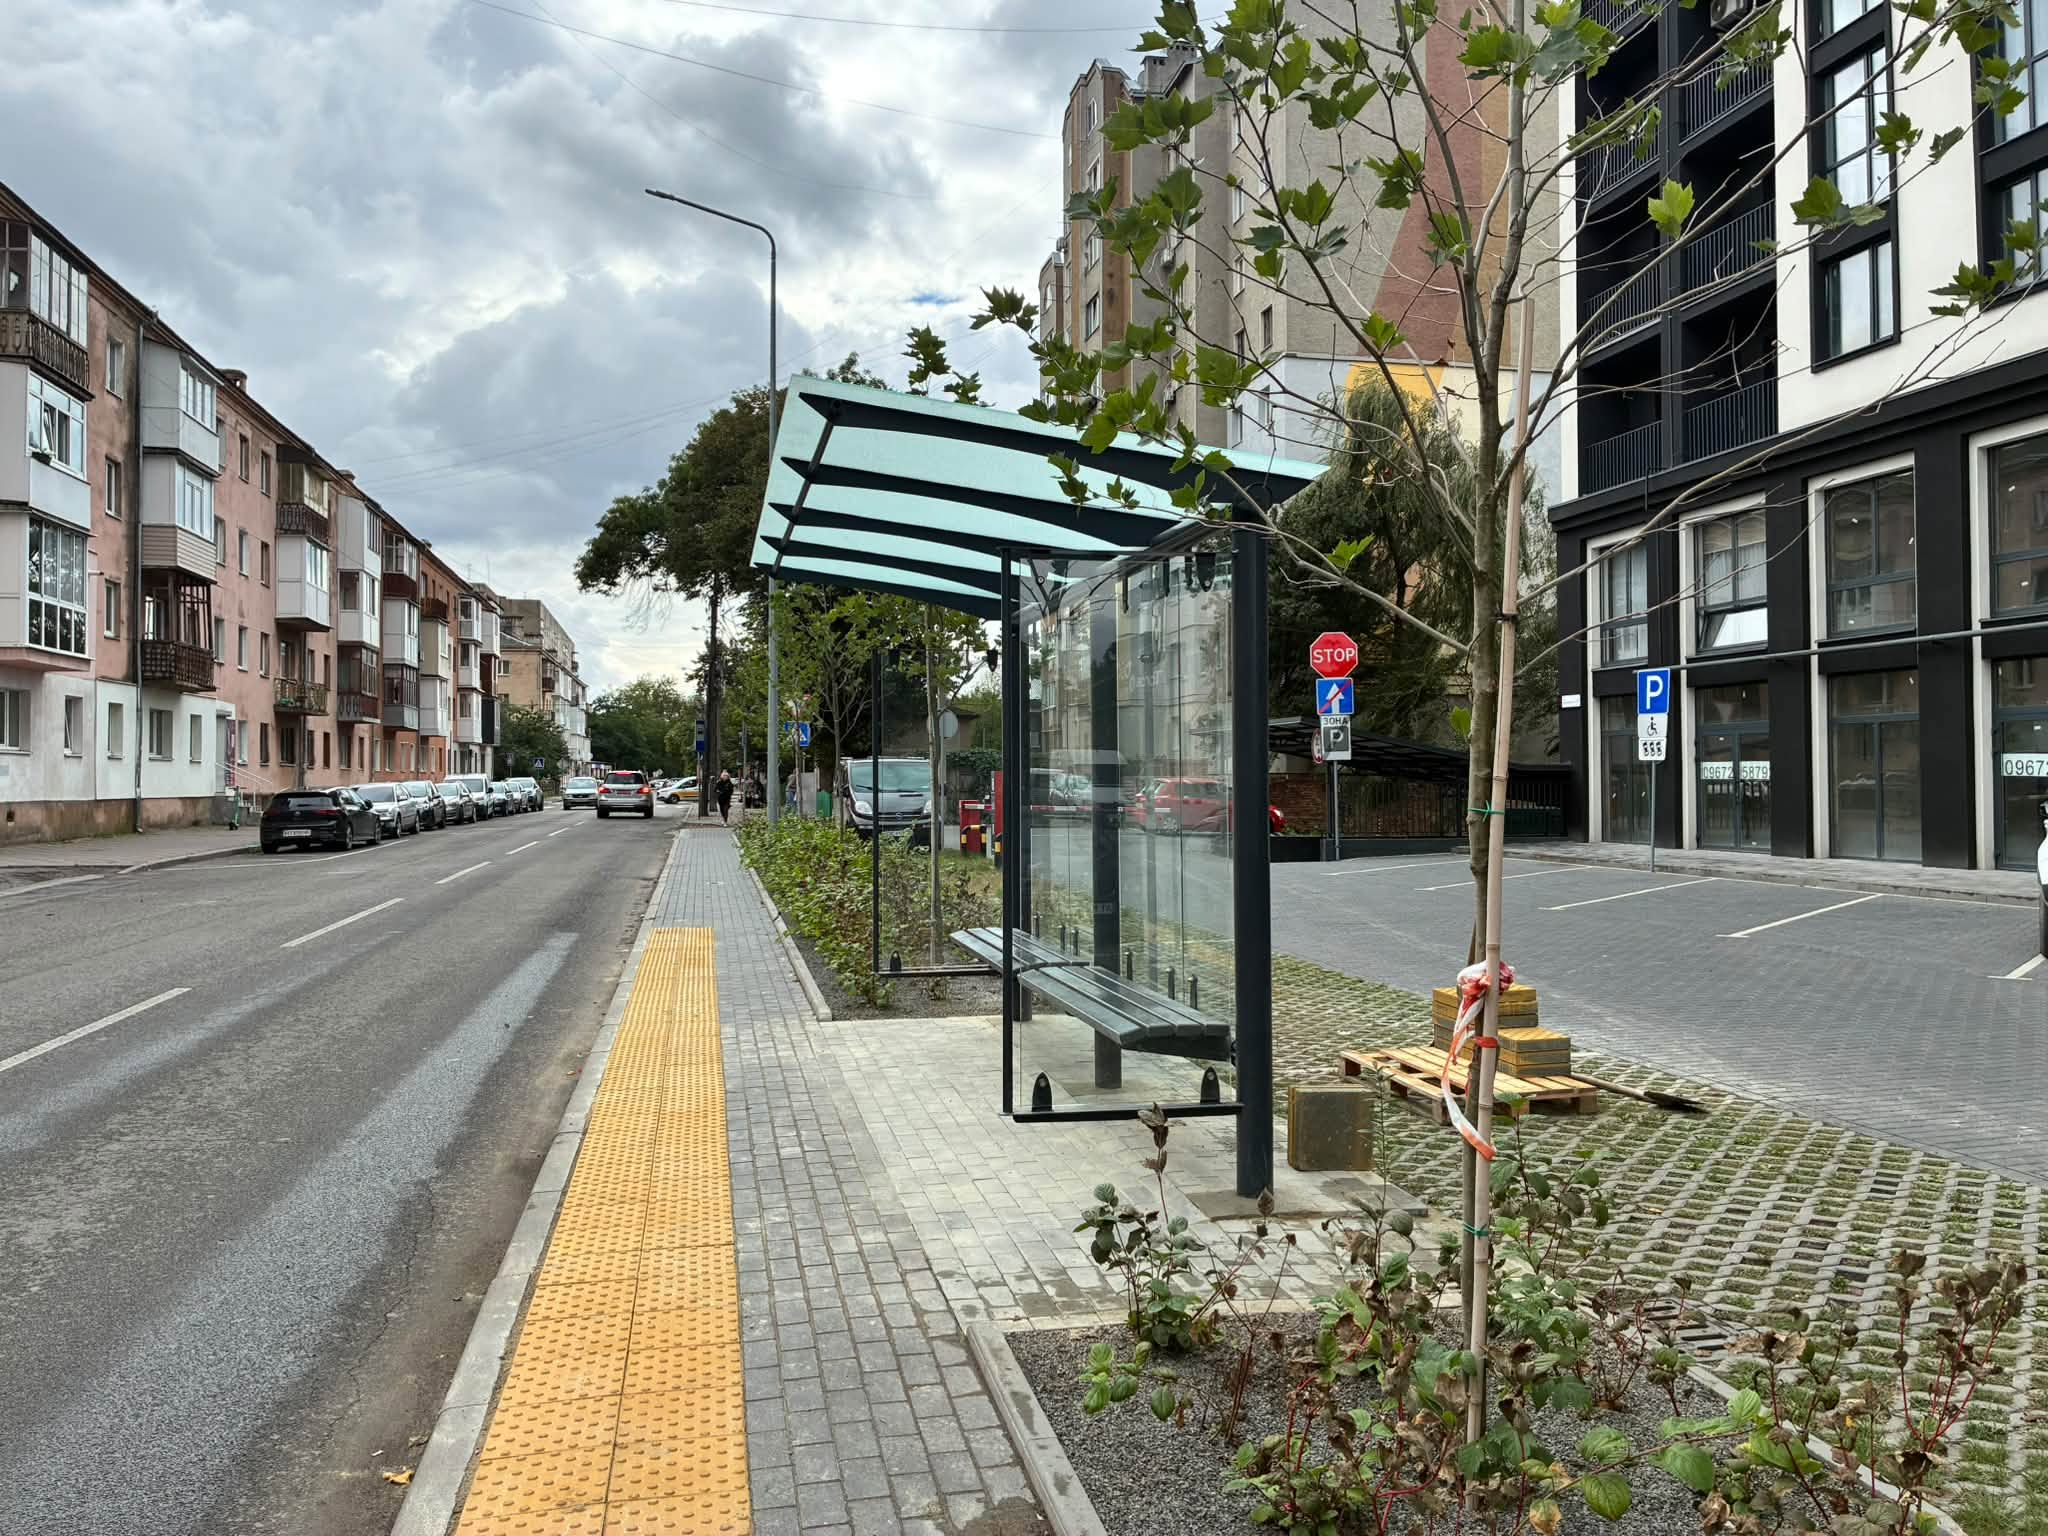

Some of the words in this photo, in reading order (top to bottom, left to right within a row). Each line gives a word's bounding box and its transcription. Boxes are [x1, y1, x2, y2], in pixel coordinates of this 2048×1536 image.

[1312, 647, 1356, 664] STOP
[1645, 674, 1664, 710] P
[1323, 717, 1349, 726] ЗОНА
[1330, 729, 1344, 749] P
[2005, 759, 2048, 776] 0967
